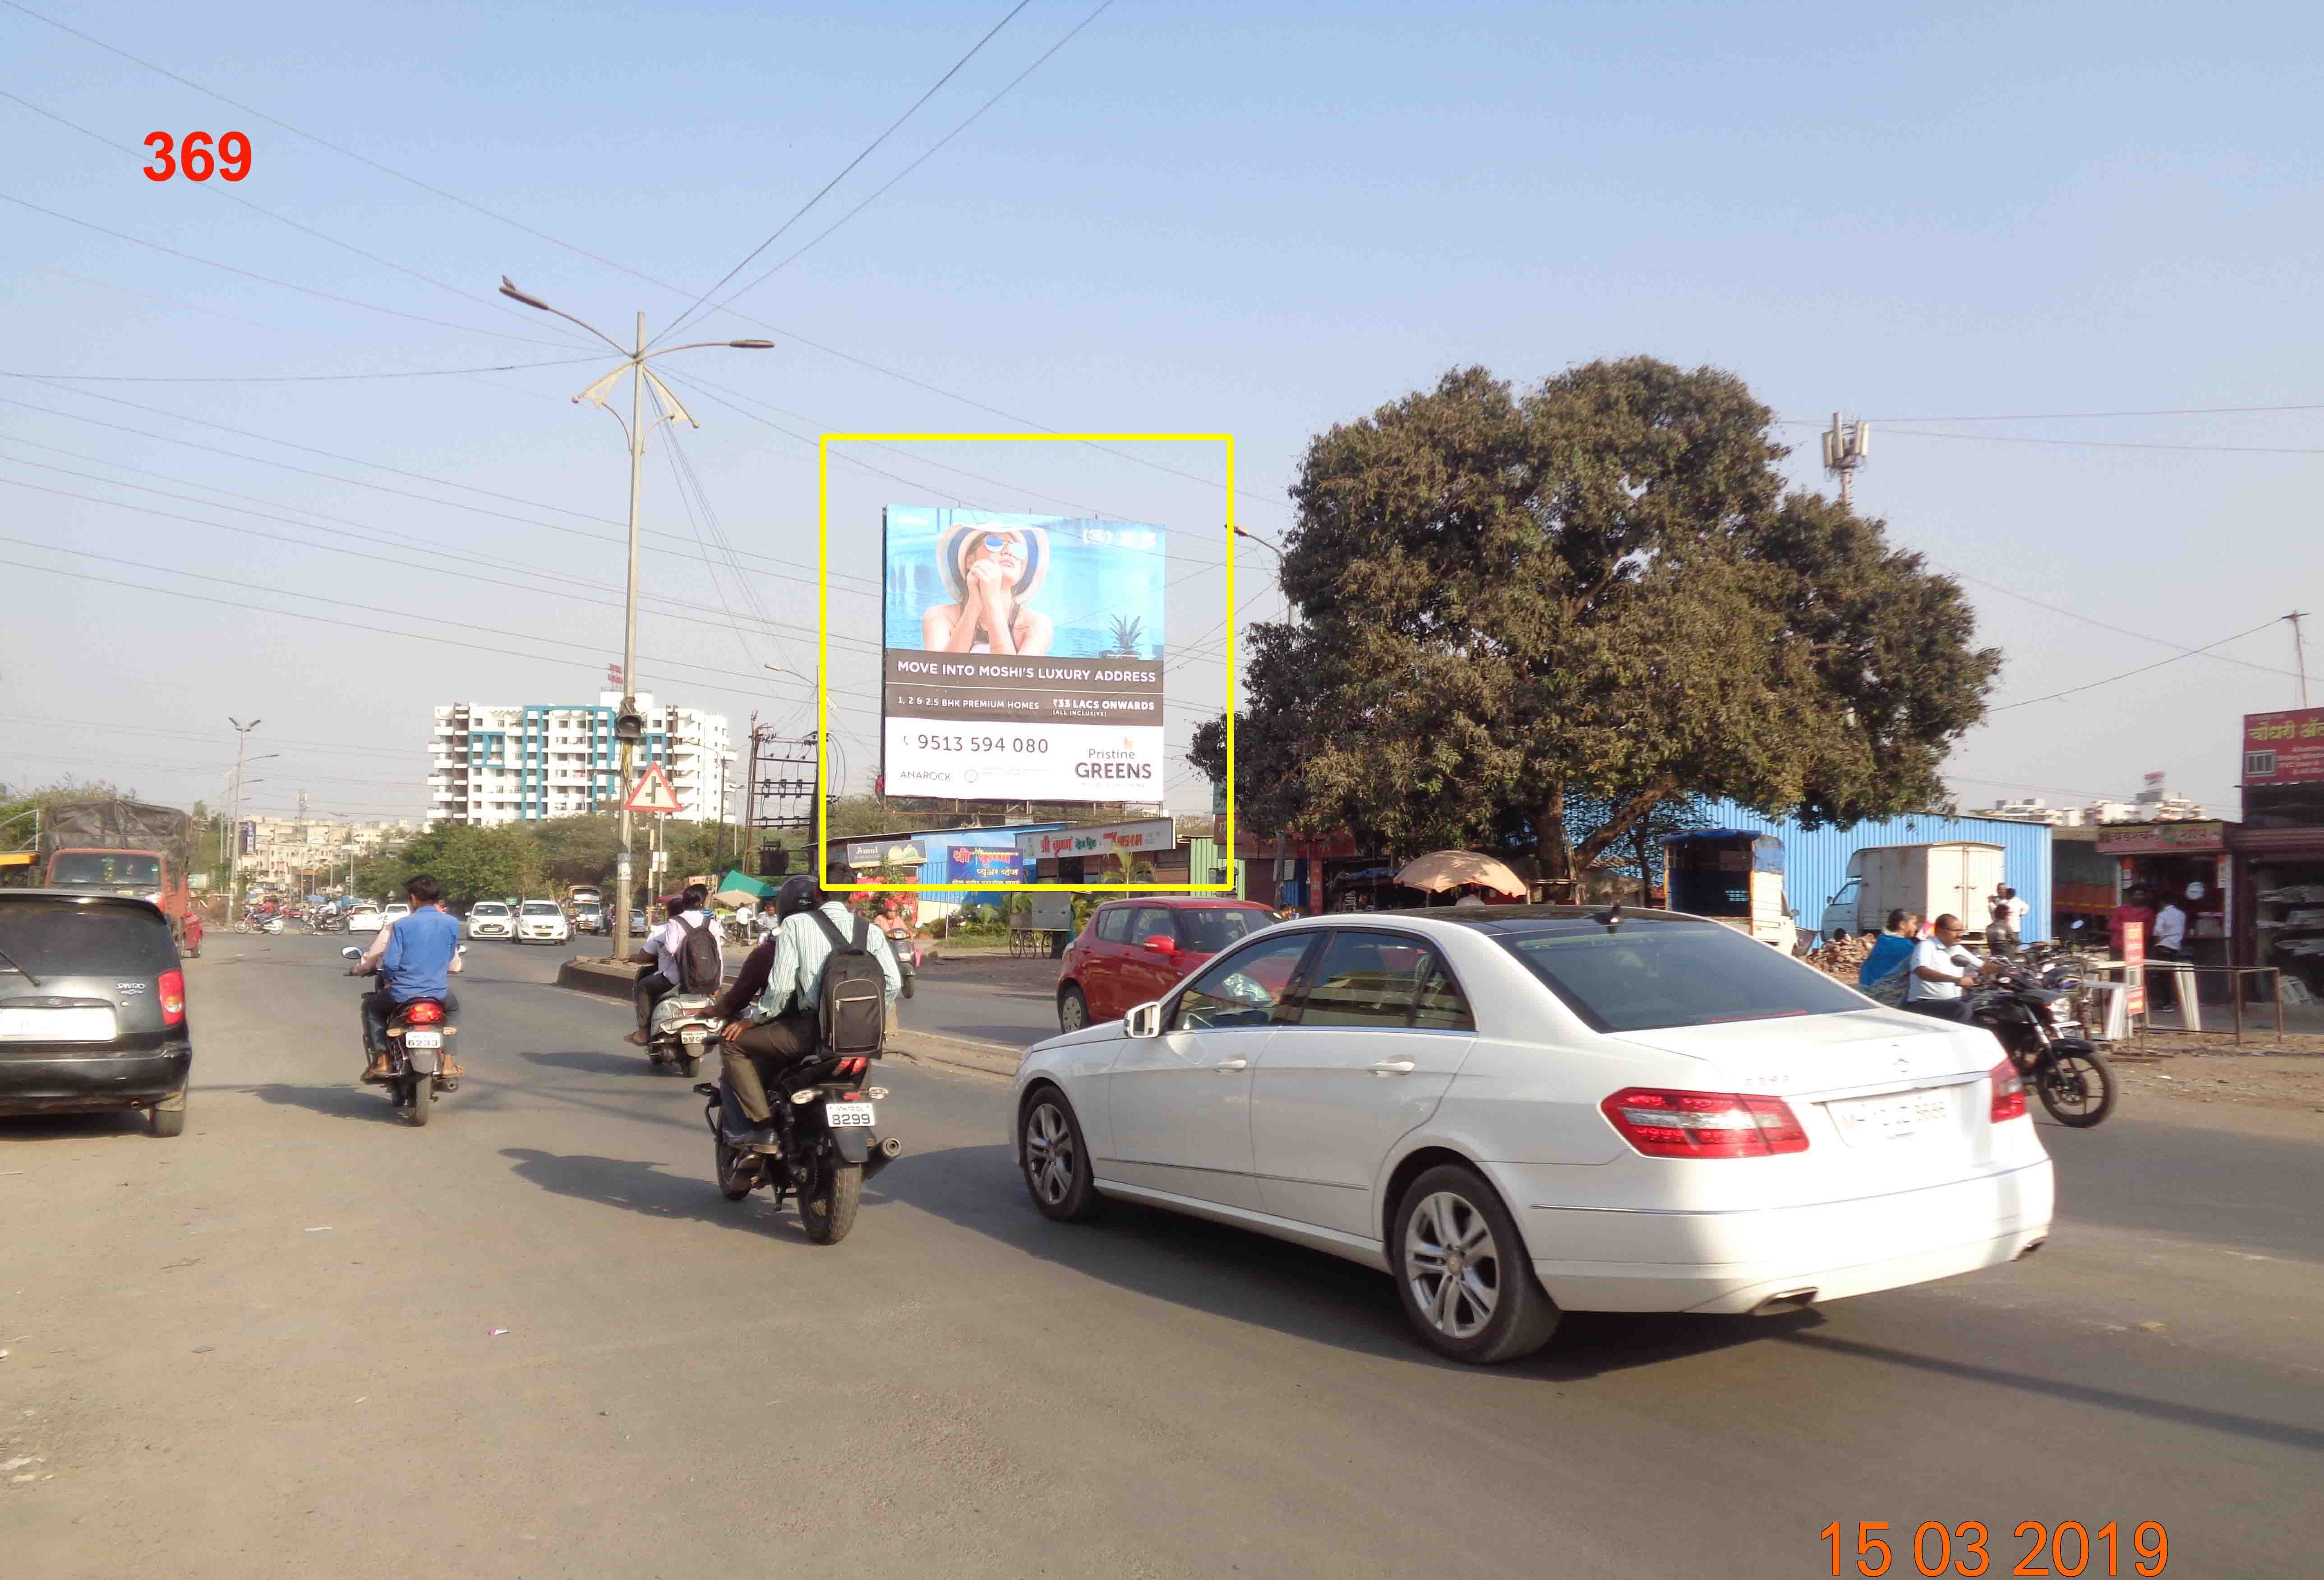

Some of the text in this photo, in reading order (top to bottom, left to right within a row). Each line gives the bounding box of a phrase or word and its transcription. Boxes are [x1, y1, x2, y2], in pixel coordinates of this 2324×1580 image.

[898, 661, 1156, 683] MOVE INTO MOSHI'S LUXURY ADDRESS
[926, 698, 939, 706] 2.5
[941, 699, 960, 707] BHK
[963, 700, 1005, 709] PREMIUM
[1007, 701, 1039, 710] HOMES
[1073, 699, 1099, 710] LACS
[1102, 701, 1155, 711] ONWARDS
[918, 735, 1049, 753] 9513 594 080
[1088, 748, 1135, 760] Pristine
[899, 771, 951, 782] ANAROCK
[1075, 762, 1152, 779] GREENS
[855, 846, 878, 855] Amul
[953, 847, 971, 864] श्री
[832, 1113, 870, 1125] 8299
